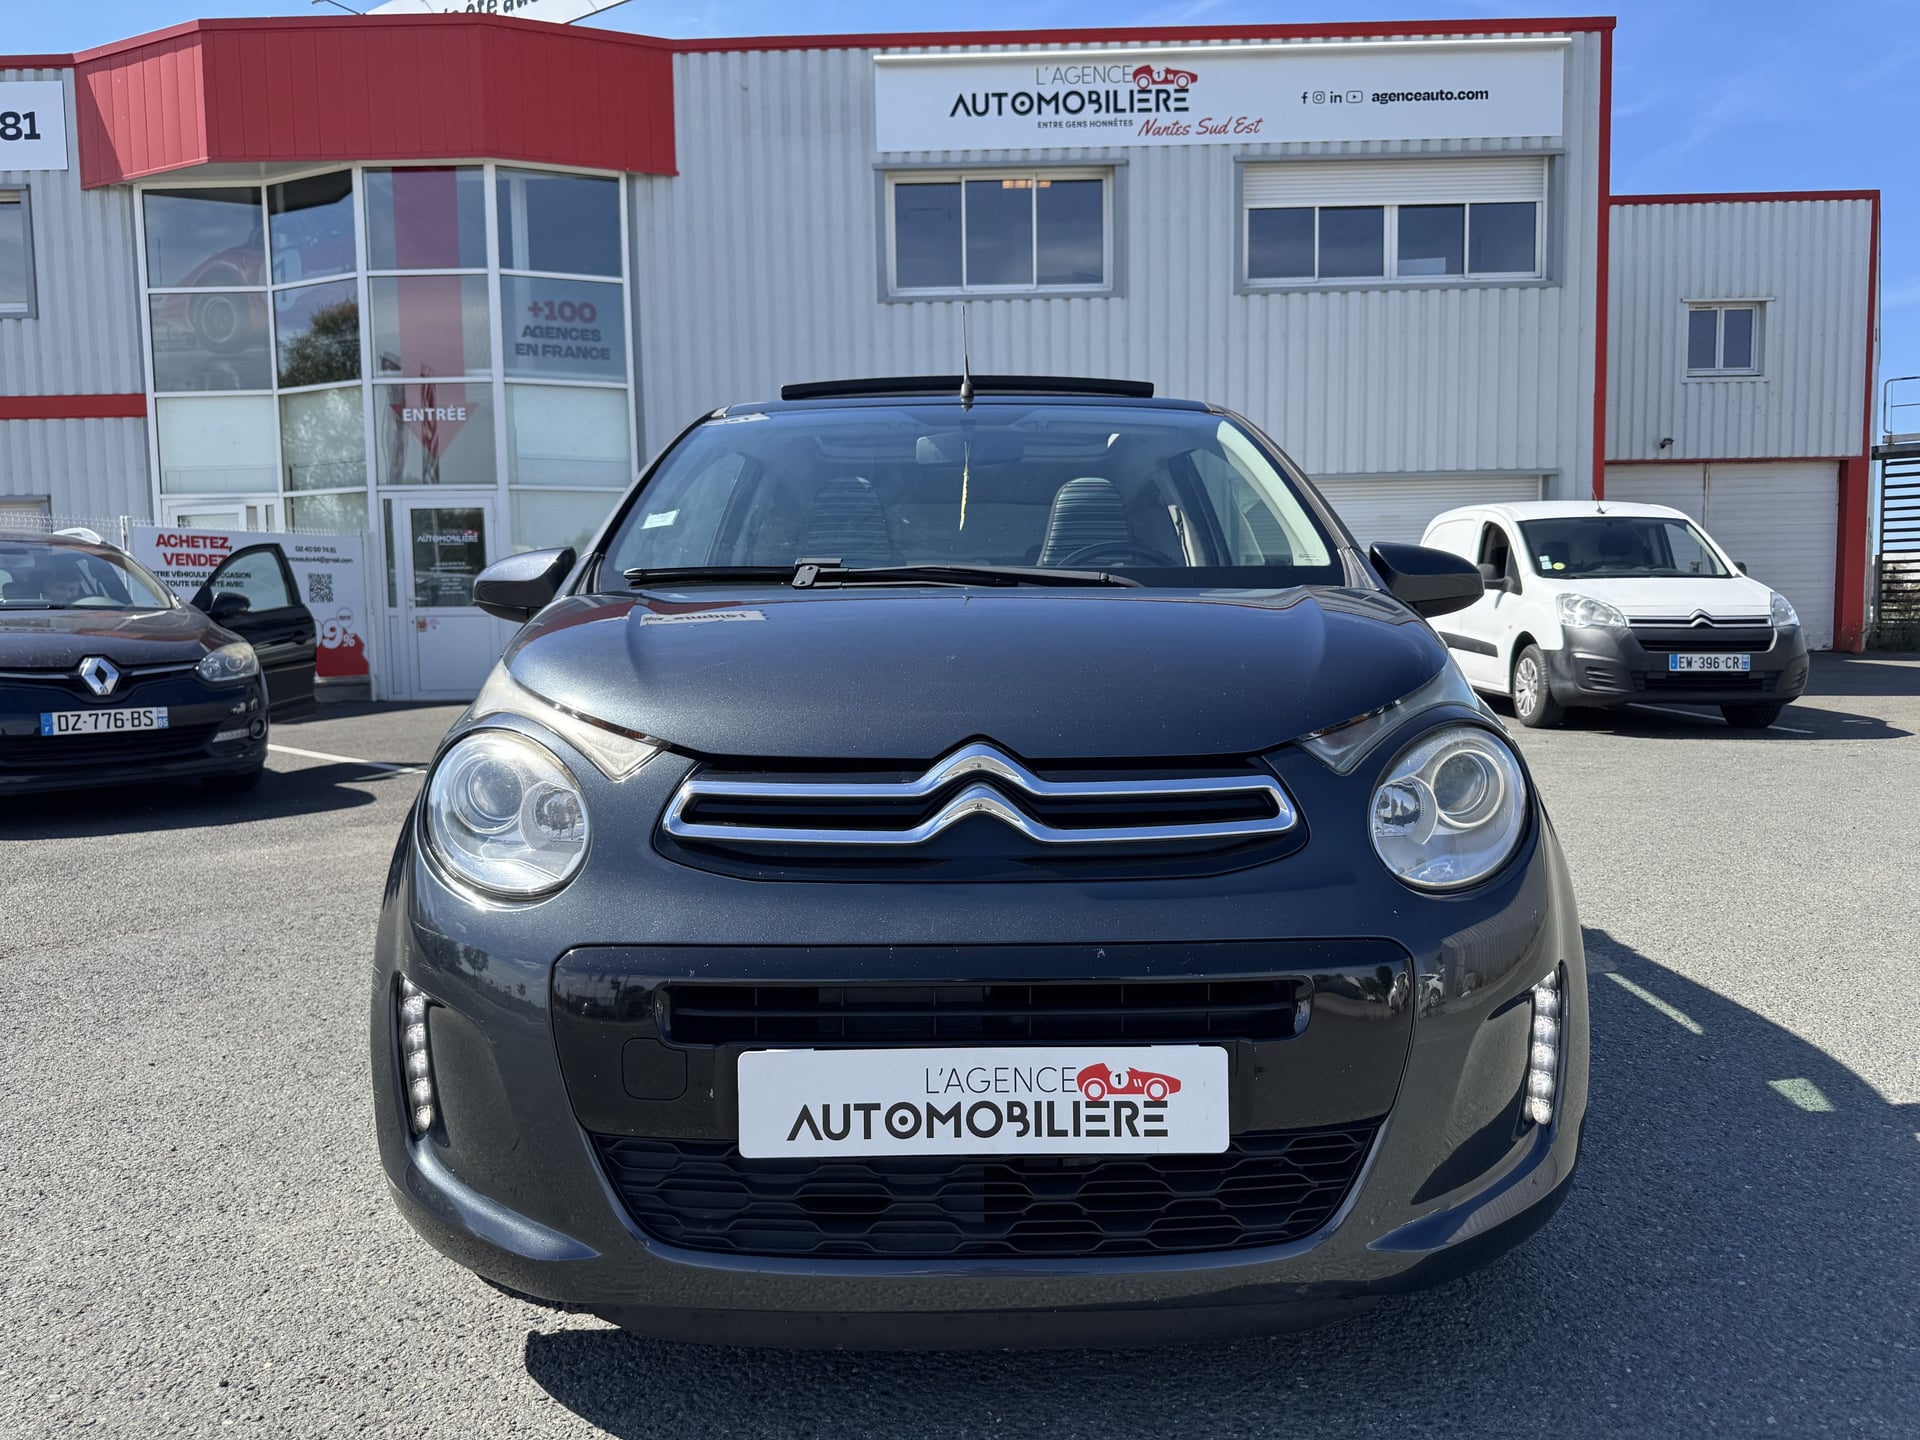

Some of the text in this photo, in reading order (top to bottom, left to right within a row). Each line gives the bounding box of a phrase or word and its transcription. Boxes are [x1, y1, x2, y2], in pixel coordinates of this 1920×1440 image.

[1036, 65, 1133, 85] L'AGENCE
[1371, 89, 1489, 105] agenceauto.com
[0, 111, 41, 141] 81
[1037, 118, 1133, 129] ENTRE GENS HONNÊTES
[1137, 116, 1264, 137] Nantes Sud Est
[528, 299, 597, 324] +100
[522, 325, 602, 342] AGENCES
[515, 343, 611, 361] EN FRANCE
[403, 405, 467, 421] ENTRÉE
[156, 534, 233, 552] ACHETEZ,
[57, 710, 154, 732] DZ-776-BS
[925, 1065, 1078, 1095] L'AGENCE
